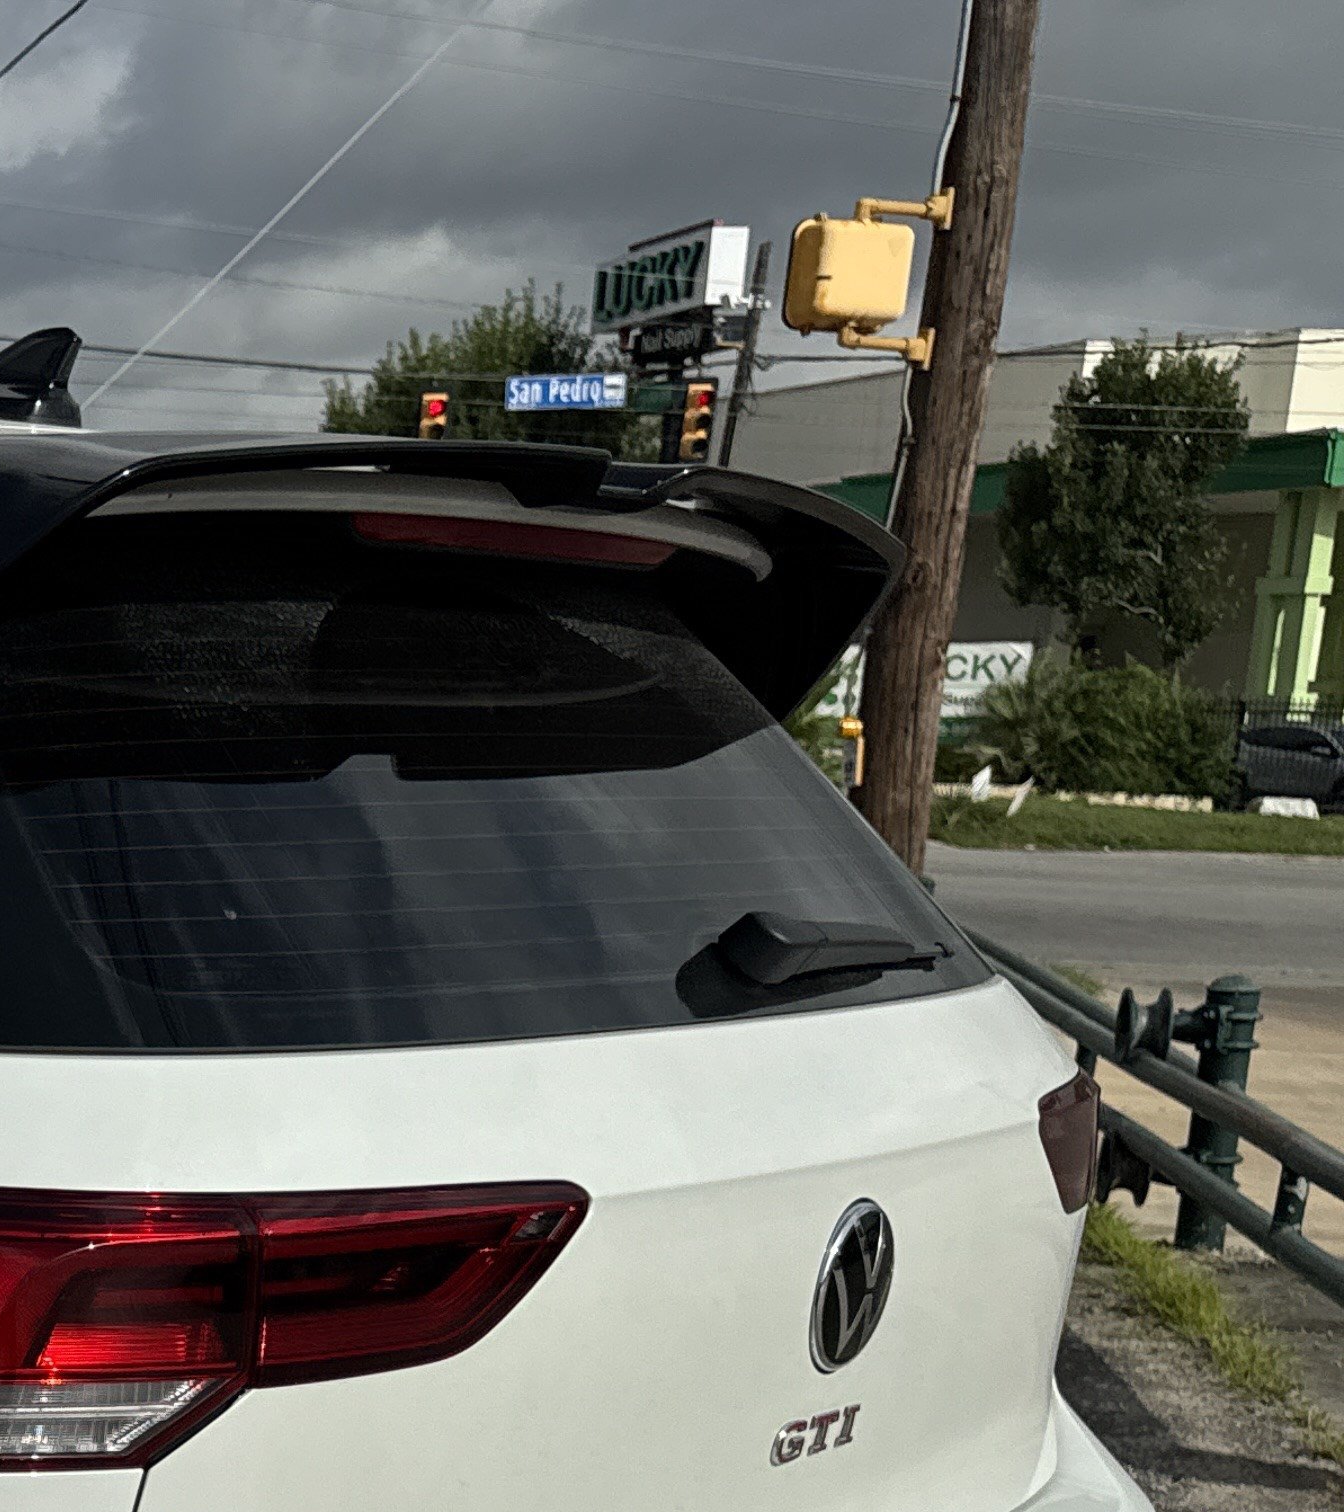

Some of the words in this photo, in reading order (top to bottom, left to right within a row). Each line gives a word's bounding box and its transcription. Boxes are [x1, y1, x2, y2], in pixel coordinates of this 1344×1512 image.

[594, 240, 704, 322] LUCKY
[509, 379, 543, 404] San
[549, 377, 601, 402] Pedro
[945, 654, 1023, 681] CKY
[770, 1403, 861, 1466] GTI
